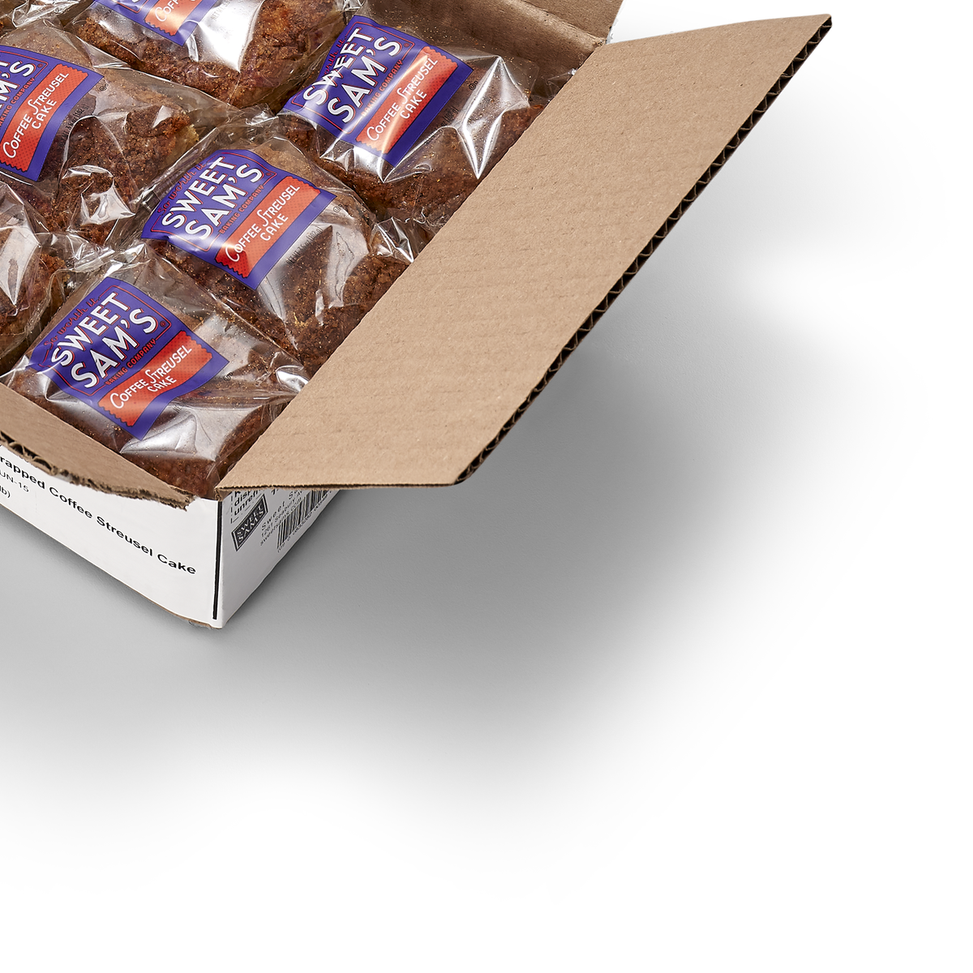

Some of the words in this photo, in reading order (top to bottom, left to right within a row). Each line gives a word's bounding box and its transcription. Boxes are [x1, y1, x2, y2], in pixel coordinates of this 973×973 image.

[303, 28, 372, 105] SWEET
[328, 37, 400, 123] SAM'S
[366, 102, 401, 141] COFFEE
[397, 58, 438, 104] STREUSEL
[3, 114, 32, 158] COFFEE
[28, 73, 69, 114] STREUSEL
[31, 100, 57, 129] CAKE
[400, 91, 427, 119] CAKE
[162, 157, 235, 228] SWEET
[185, 164, 262, 240] SAM'S
[226, 224, 262, 262] COFFEE
[257, 185, 300, 227] STREUSEL
[260, 213, 288, 241] CAKE
[51, 292, 128, 366] SWEET
[71, 309, 157, 388] SAM'S
[110, 379, 148, 409] COFFEE
[145, 345, 192, 382] STREUSEL
[147, 376, 177, 393] CAKE
[0, 486, 10, 498] lb)
[49, 487, 94, 519] Coffee
[96, 515, 153, 557] Streusel
[157, 553, 197, 575] Cake
